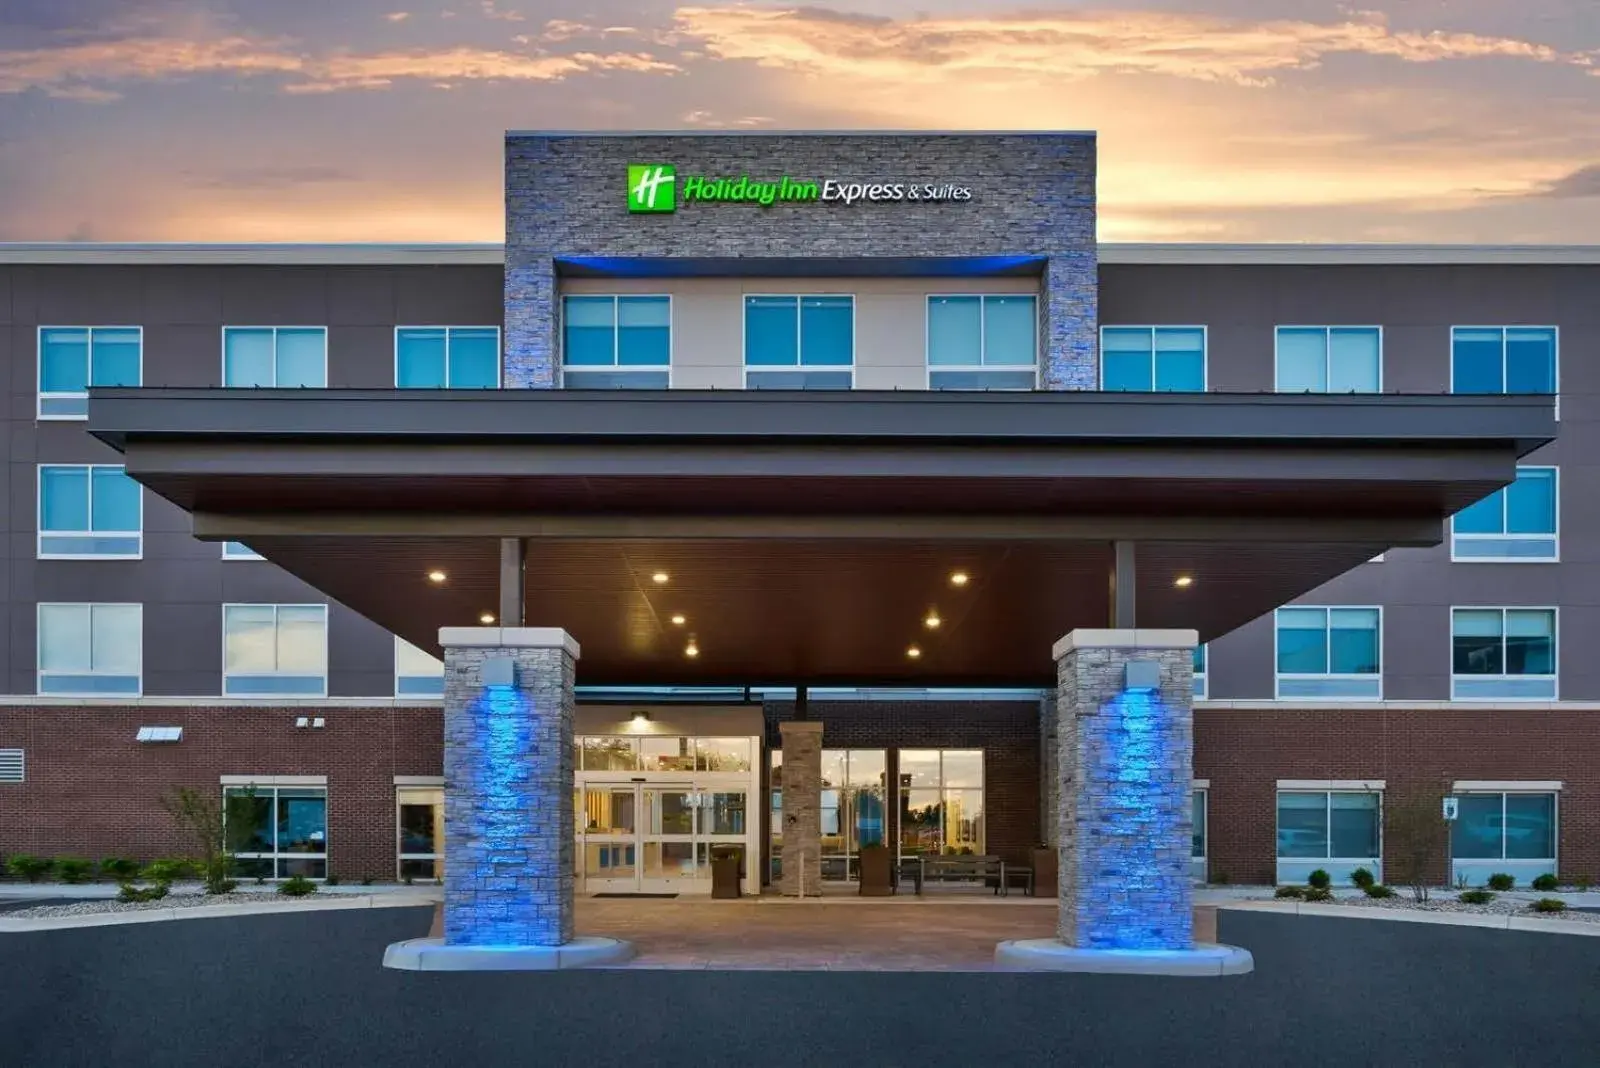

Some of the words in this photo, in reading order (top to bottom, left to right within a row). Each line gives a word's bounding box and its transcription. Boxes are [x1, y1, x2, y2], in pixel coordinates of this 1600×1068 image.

[632, 167, 675, 208] H
[684, 176, 775, 205] Holiday
[780, 176, 817, 200] Inn
[822, 179, 903, 205] Express
[908, 184, 920, 200] &
[923, 184, 971, 200] Suites
